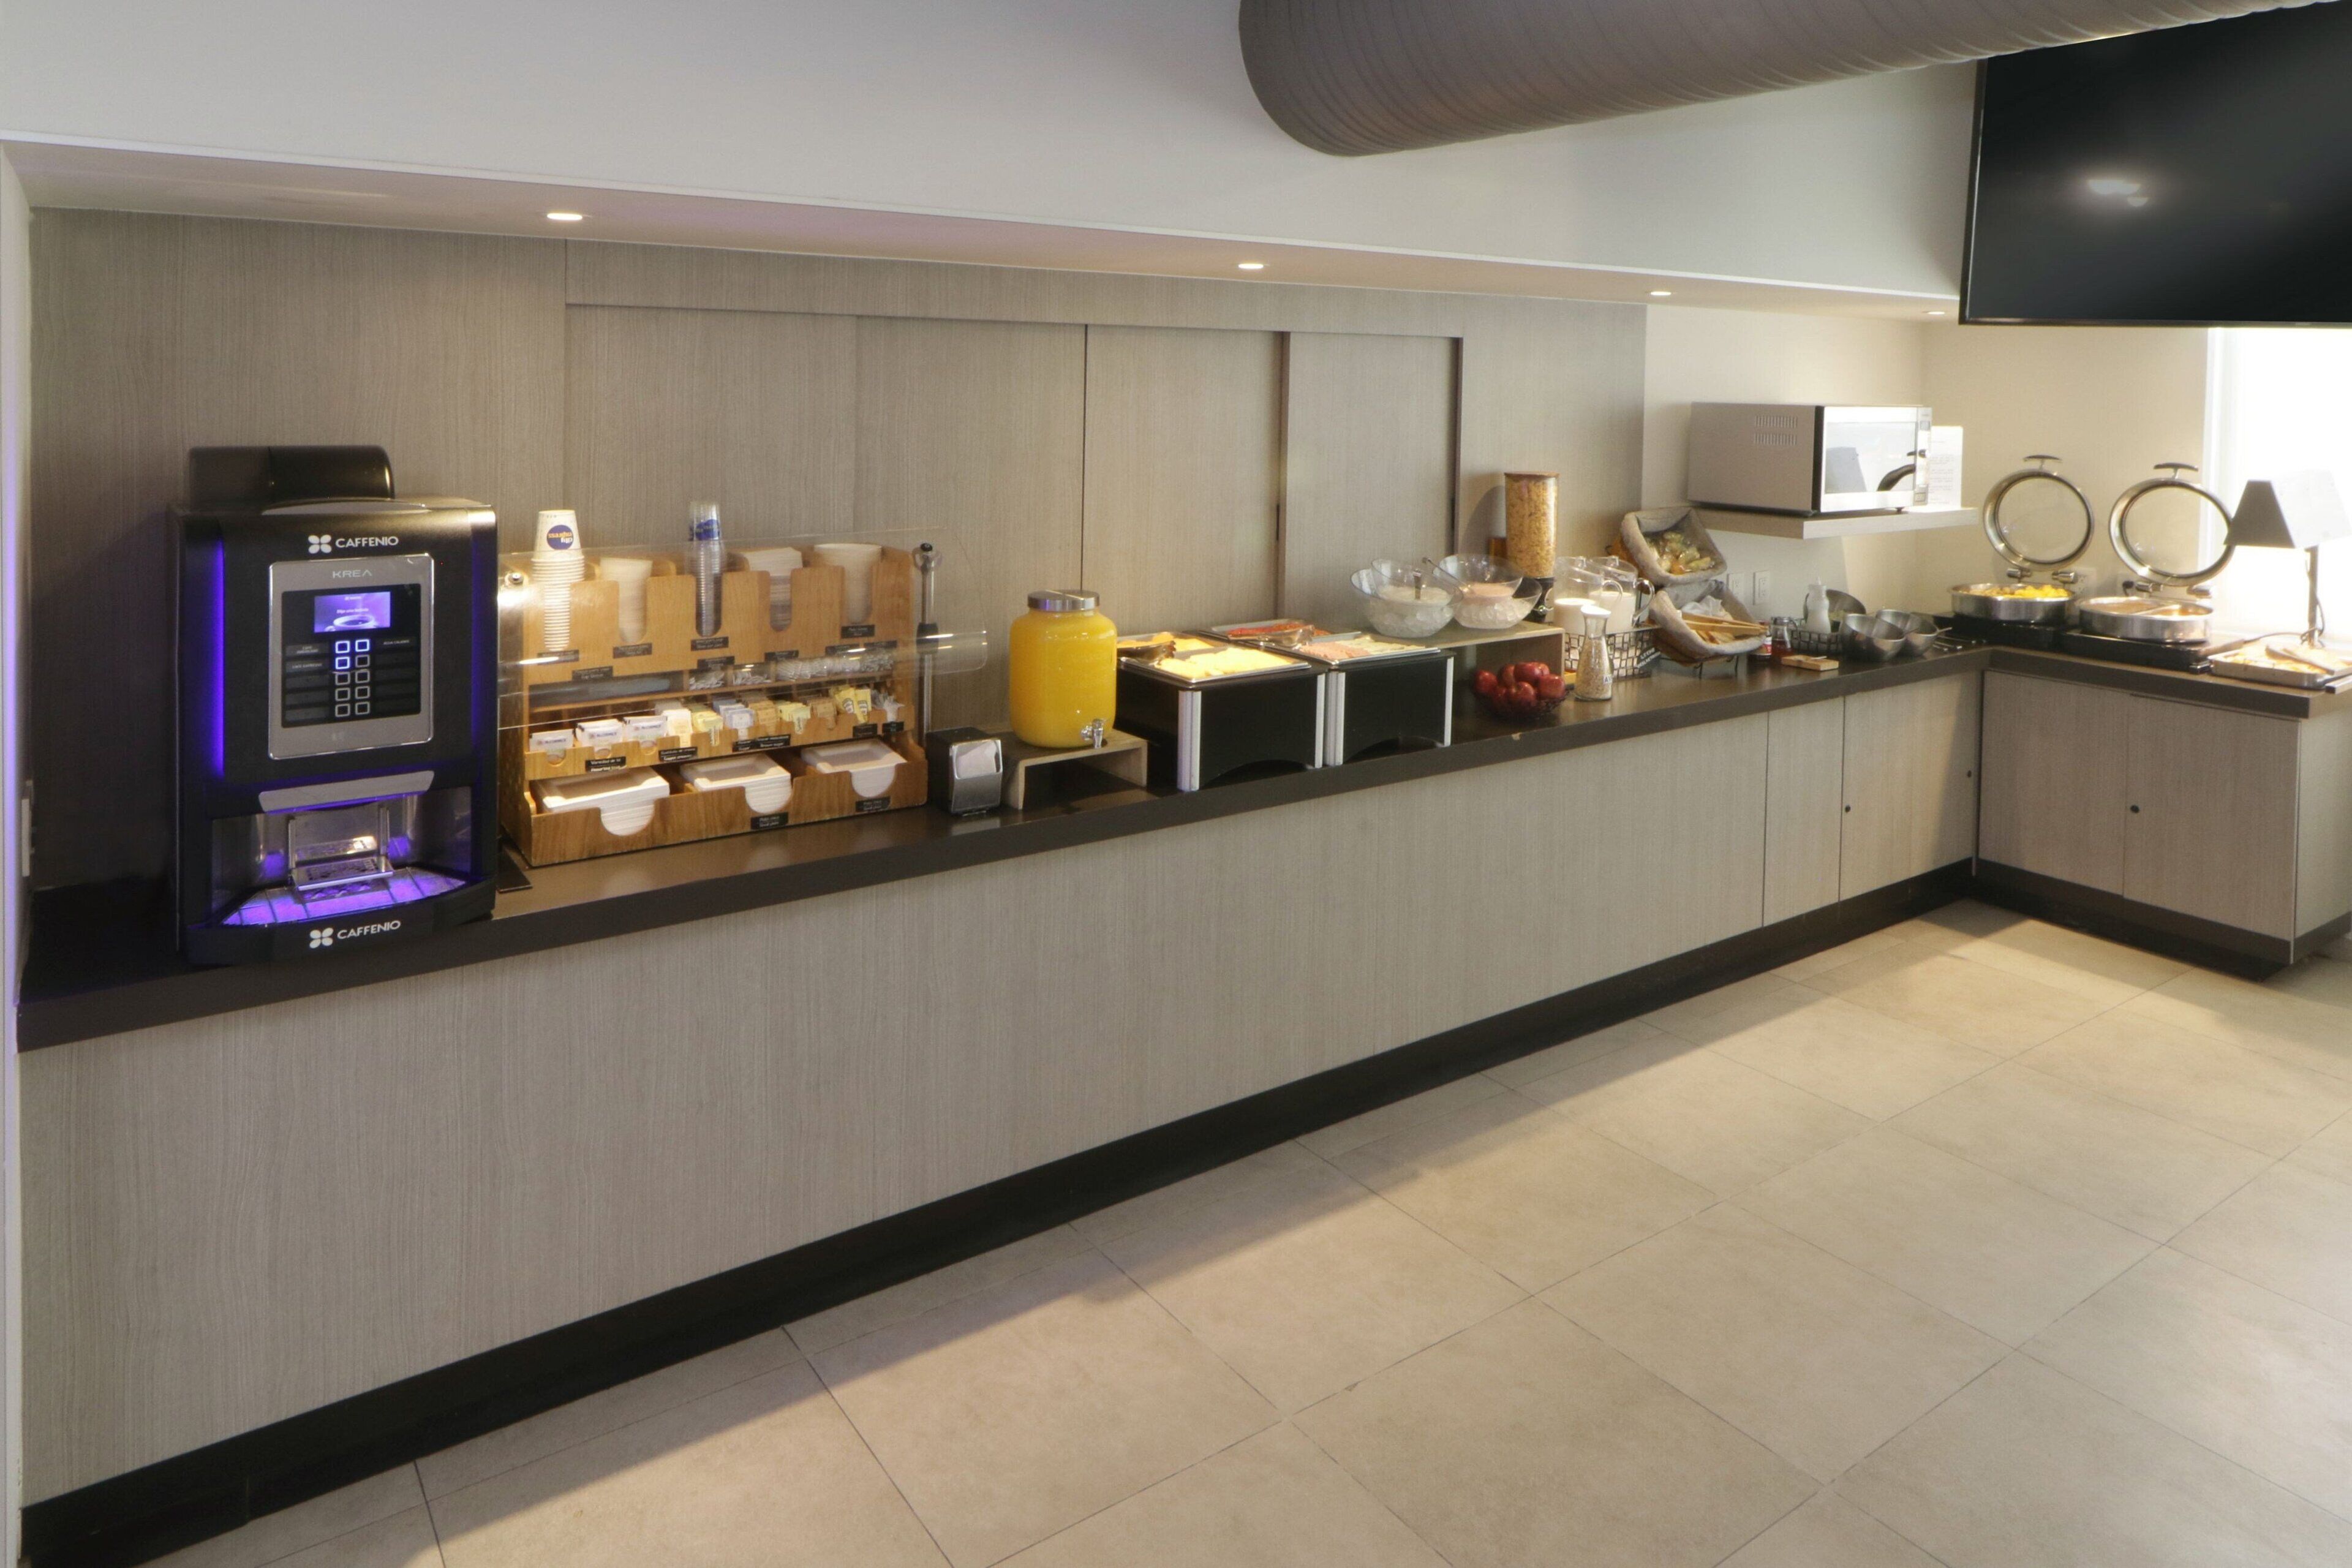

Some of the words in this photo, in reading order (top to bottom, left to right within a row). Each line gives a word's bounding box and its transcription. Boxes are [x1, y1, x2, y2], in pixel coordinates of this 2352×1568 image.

[335, 536, 399, 549] CAFFENIO
[332, 569, 373, 579] KREA
[337, 920, 401, 940] CAFFENIO
